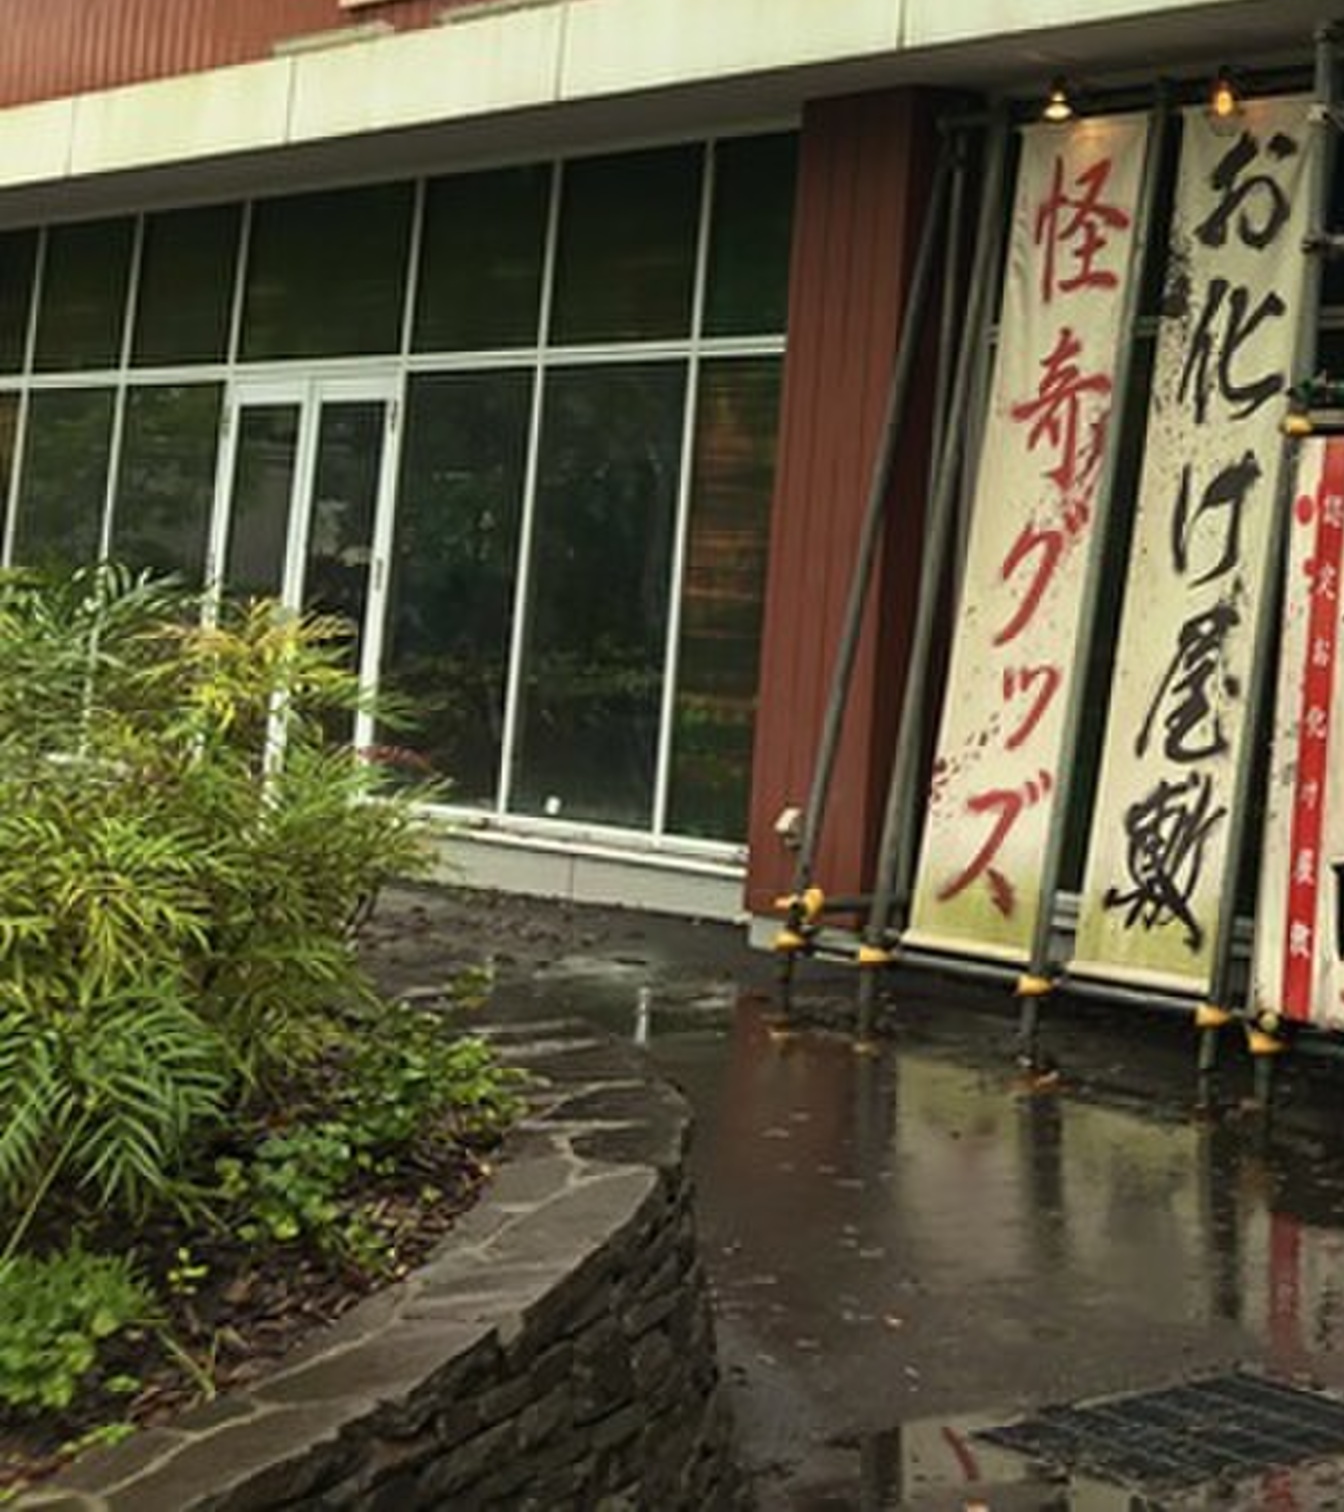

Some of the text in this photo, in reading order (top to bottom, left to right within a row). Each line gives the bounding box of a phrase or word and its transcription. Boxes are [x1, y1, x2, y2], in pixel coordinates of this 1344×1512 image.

[936, 153, 1132, 919] 怪奇グッズ
[1103, 129, 1299, 953] お化け屋敷
